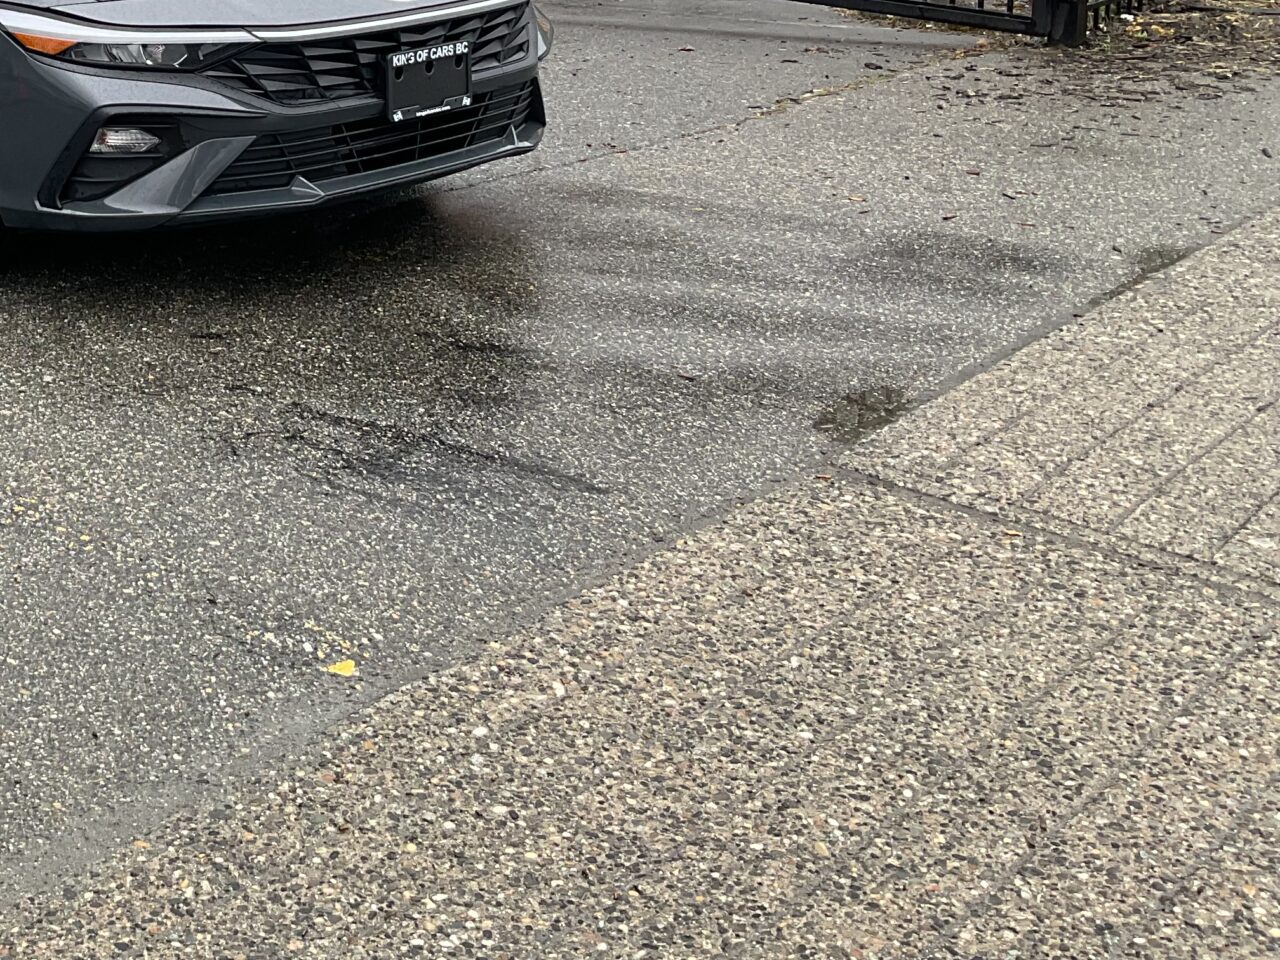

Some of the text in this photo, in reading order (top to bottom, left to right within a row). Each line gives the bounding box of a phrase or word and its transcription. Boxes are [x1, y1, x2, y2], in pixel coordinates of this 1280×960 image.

[392, 42, 469, 67] KING OF CARS BC
